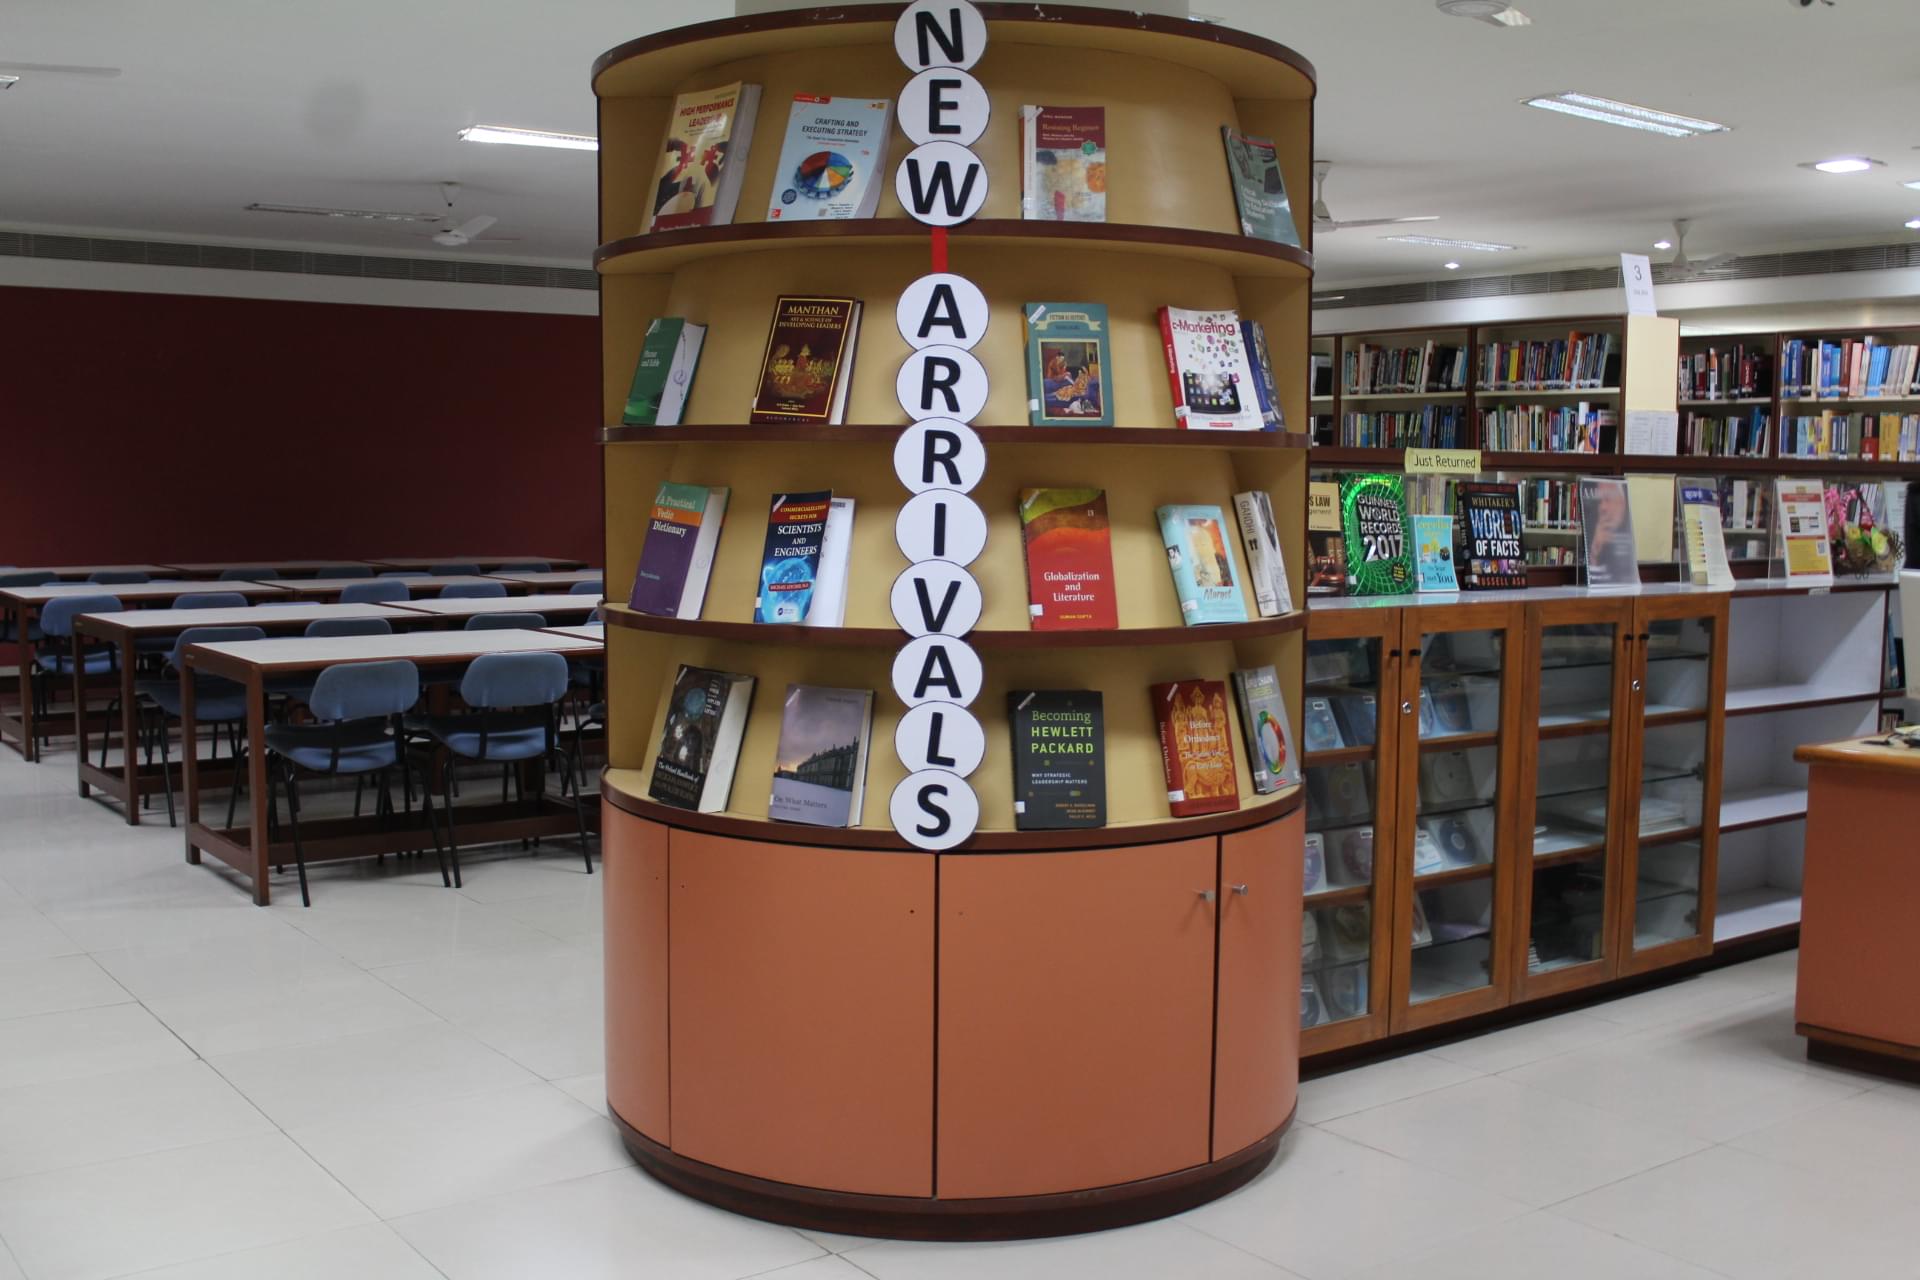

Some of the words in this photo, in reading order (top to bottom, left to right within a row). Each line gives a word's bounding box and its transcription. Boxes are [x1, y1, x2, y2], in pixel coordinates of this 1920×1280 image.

[680, 104, 695, 116] HIGH
[696, 98, 735, 114] PERFORMANCE
[907, 8, 980, 217] NEW
[815, 117, 845, 128] CRAFTING
[846, 120, 860, 128] AND
[802, 125, 836, 135] EXECUTING
[837, 127, 868, 137] STRATEGY
[1633, 264, 1642, 281] 3
[788, 304, 839, 315] MANTHAN
[779, 321, 815, 329] DEVELOPING
[1414, 455, 1433, 467] Just
[1436, 455, 1476, 468] Returned
[667, 496, 696, 510] Practical
[1315, 496, 1330, 507] LAW
[1357, 494, 1398, 509] GUINNESS
[1472, 496, 1515, 507] WHITAKER'S
[1359, 505, 1400, 522] WORLD
[653, 520, 687, 538] Dictionary
[778, 523, 823, 535] SCIENTISTS
[1361, 521, 1403, 535] RECORDS
[1469, 508, 1521, 539] WORLD
[792, 537, 806, 545] AND
[774, 545, 818, 557] ENGINEERS
[1363, 534, 1404, 562] 2017
[1476, 540, 1488, 557] OF
[1491, 540, 1520, 557] FACTS
[913, 283, 967, 839] ARRIVALS
[1044, 571, 1100, 581] Globalization
[1065, 582, 1081, 591] and
[1053, 592, 1095, 602] Literature
[1032, 710, 1091, 724] Becoming
[1031, 726, 1094, 737] HEWLETT
[1031, 742, 1094, 753] PACKARD
[785, 796, 801, 805] What
[803, 799, 828, 809] Matters
